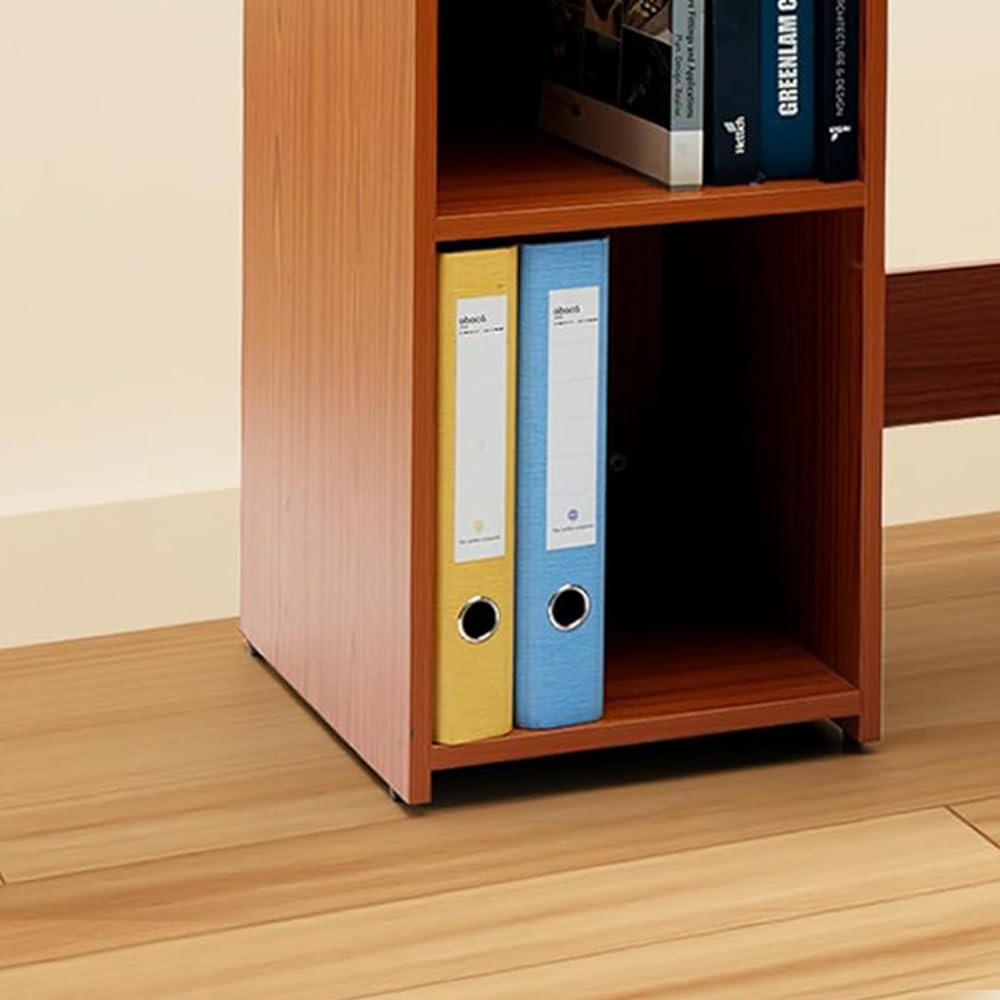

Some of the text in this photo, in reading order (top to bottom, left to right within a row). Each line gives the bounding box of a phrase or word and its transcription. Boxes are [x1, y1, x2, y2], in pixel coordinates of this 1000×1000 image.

[778, 15, 798, 117] GREENLAM
[835, 68, 846, 77] &
[835, 78, 846, 117] DESIGN
